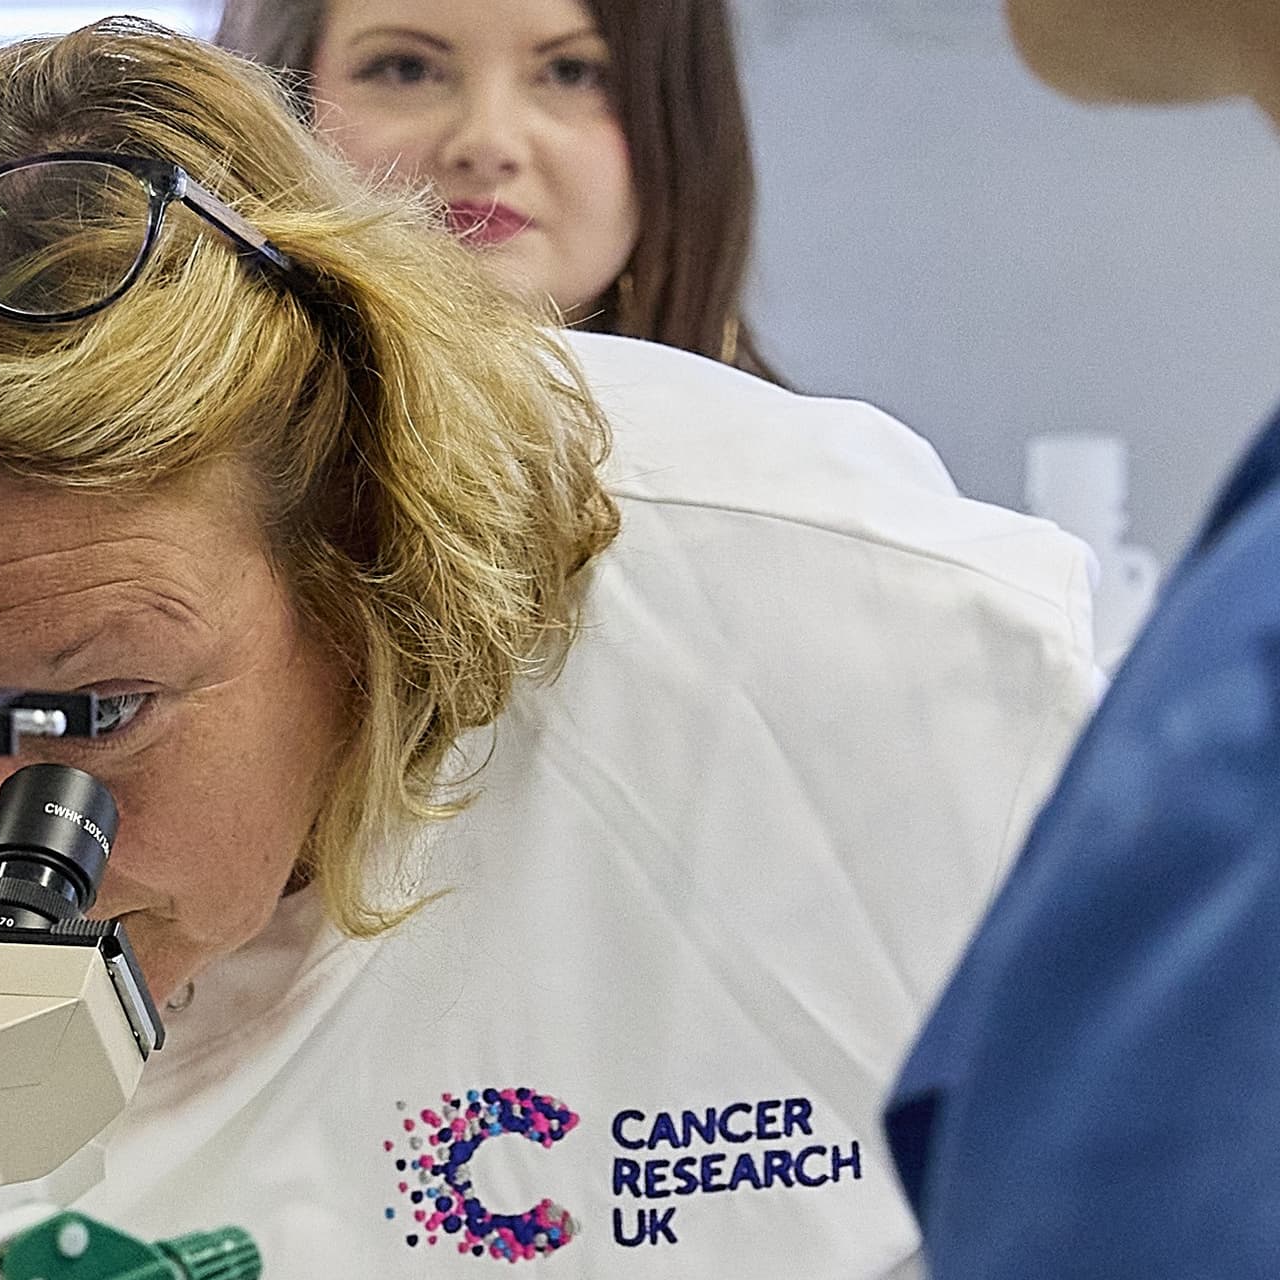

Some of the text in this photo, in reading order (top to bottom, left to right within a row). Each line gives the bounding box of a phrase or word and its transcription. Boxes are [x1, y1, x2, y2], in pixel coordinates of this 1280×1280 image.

[44, 802, 83, 826] CWHK
[0, 916, 15, 928] 70
[611, 1097, 813, 1150] CANCER
[612, 1140, 862, 1199] RESEARCH
[612, 1206, 678, 1248] UK
